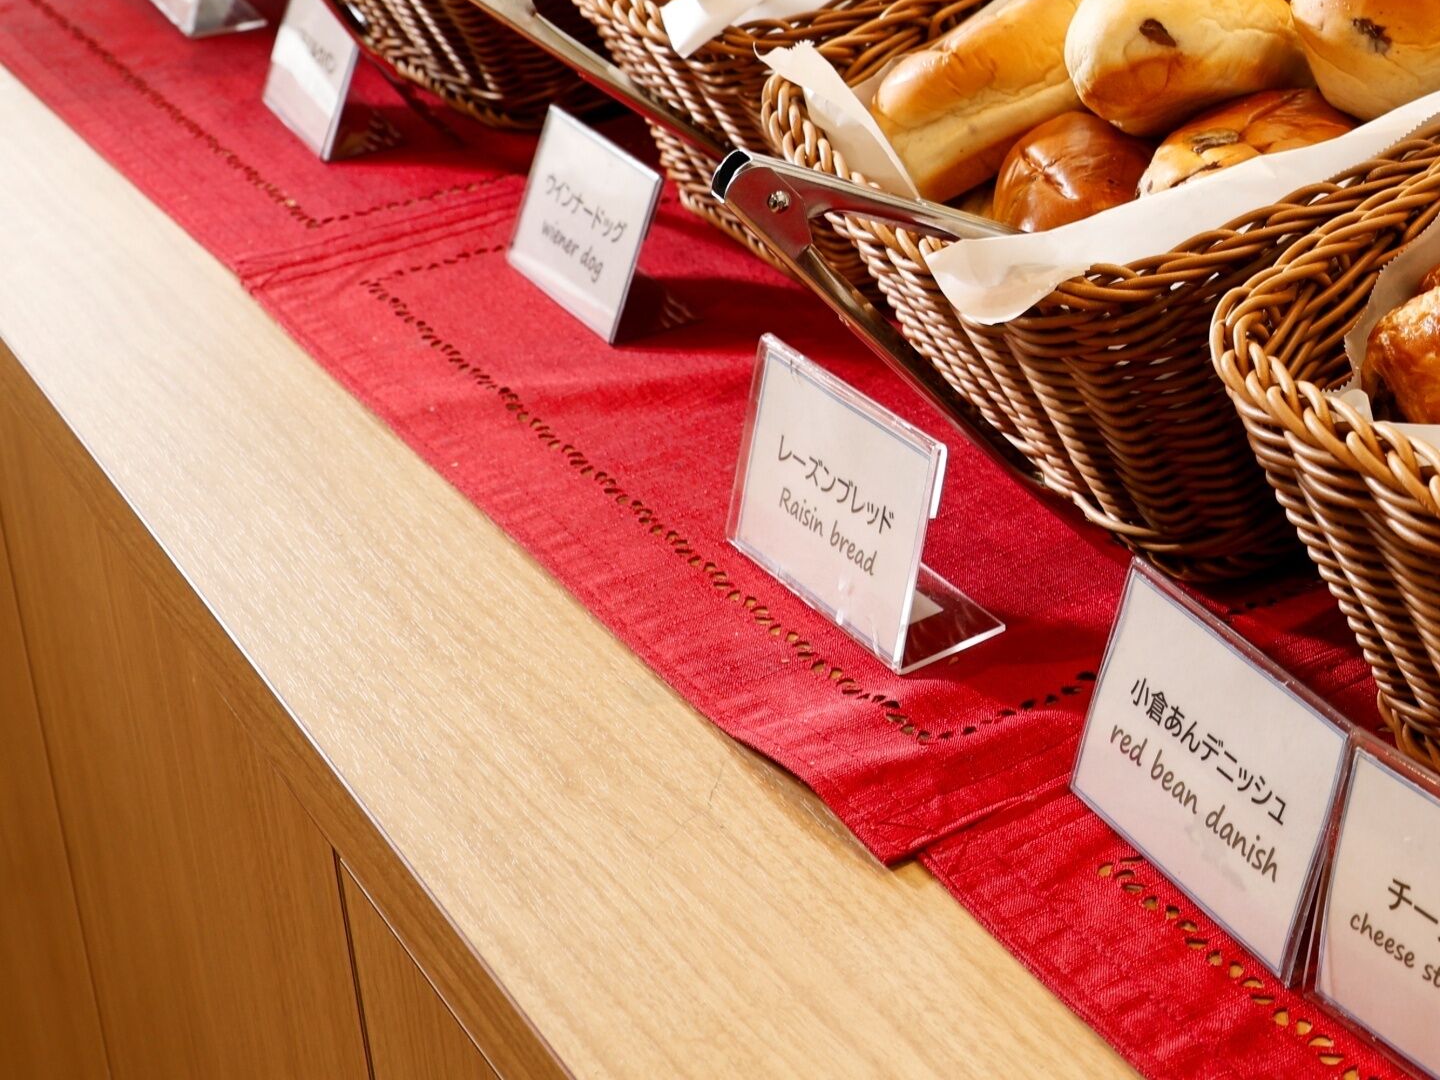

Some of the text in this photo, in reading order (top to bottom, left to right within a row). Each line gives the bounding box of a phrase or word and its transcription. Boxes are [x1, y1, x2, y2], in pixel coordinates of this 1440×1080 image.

[541, 221, 604, 284] wiener dog
[777, 435, 895, 534] レーズンブレッド
[779, 487, 878, 577] Raisin bread
[1130, 677, 1287, 826] 小倉あんデニッシュ
[1110, 724, 1279, 883] red bean danish
[1350, 913, 1415, 969] cheese
